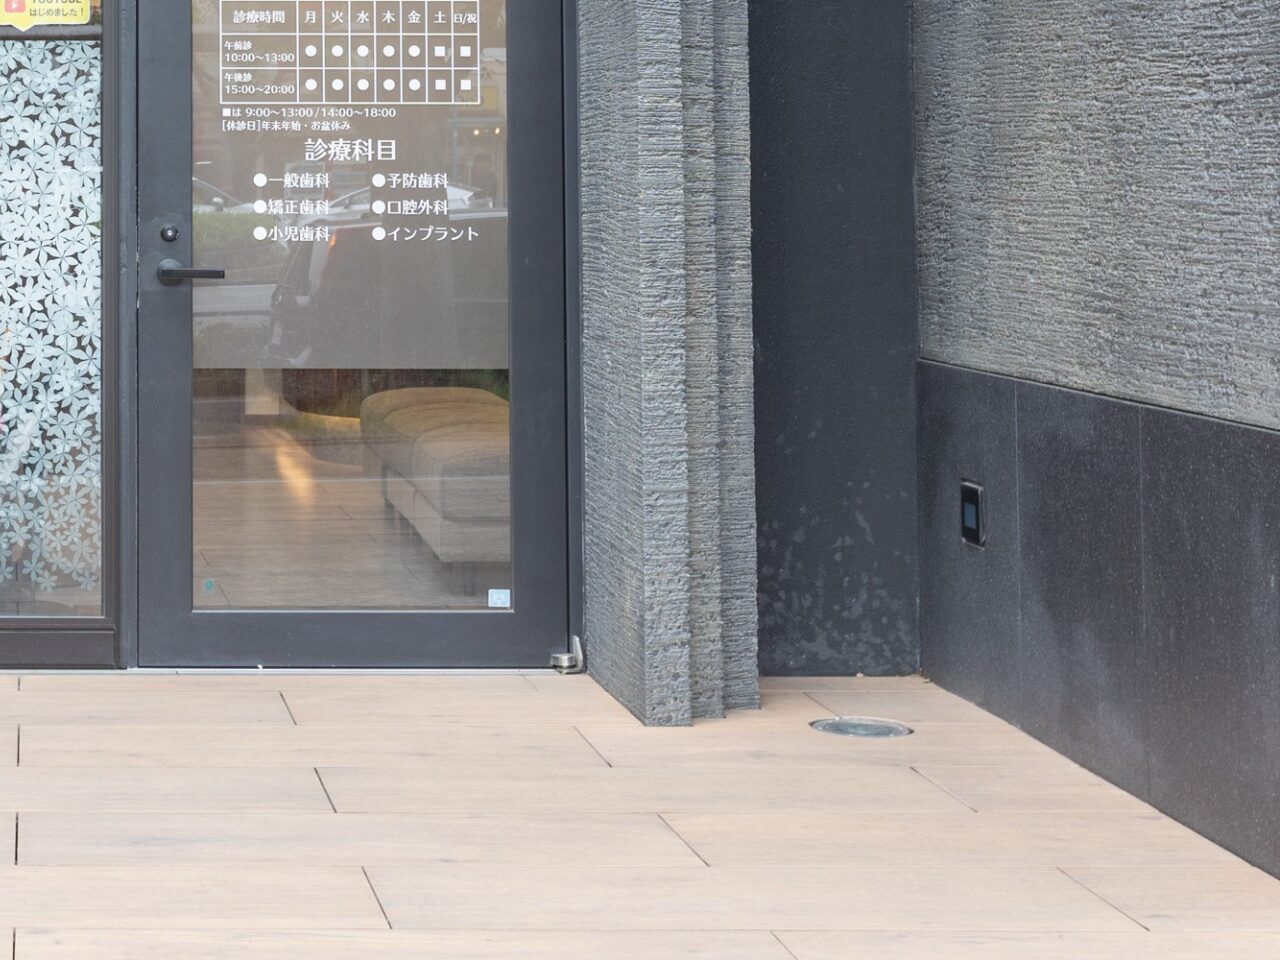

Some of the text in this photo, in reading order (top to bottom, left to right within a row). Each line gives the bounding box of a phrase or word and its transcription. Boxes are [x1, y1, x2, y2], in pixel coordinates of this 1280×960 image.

[233, 10, 477, 24] 診療時間 月 火 水 木 金 土 日/祝
[224, 40, 252, 51] 午前診
[224, 72, 252, 83] 午後診
[304, 138, 396, 161] 診療科目
[268, 173, 330, 188] 一般歯科
[387, 173, 448, 188] 予防歯科
[268, 200, 330, 215] 矯正歯科
[387, 200, 448, 215] 口腔外科
[268, 226, 330, 242] 小児歯科
[387, 226, 479, 241] インプラント
